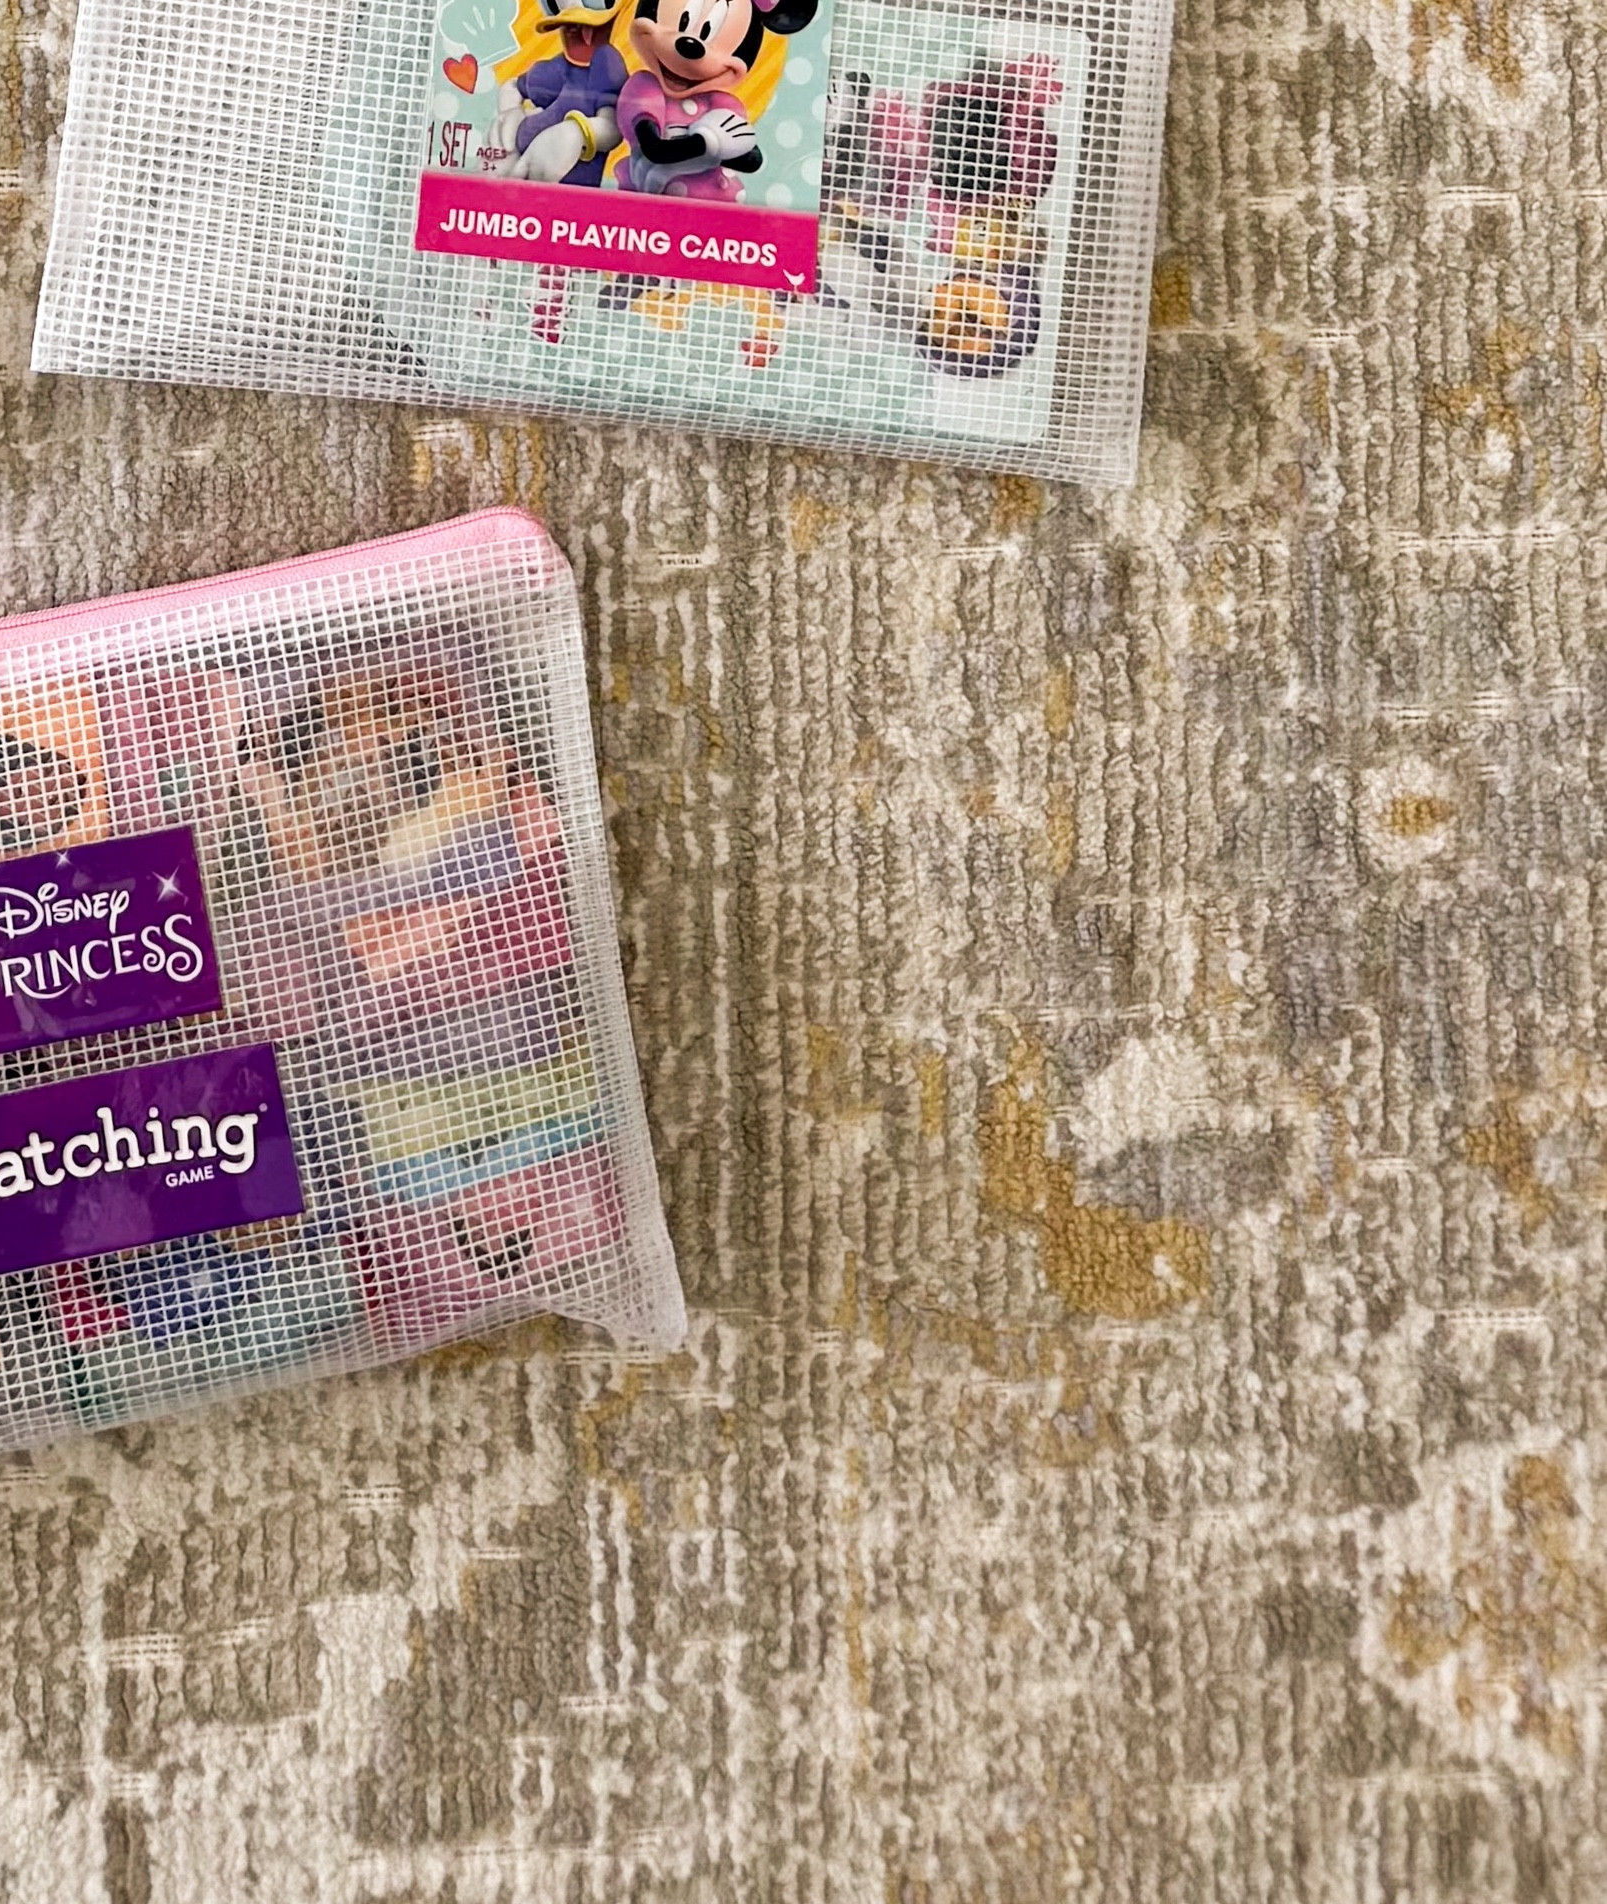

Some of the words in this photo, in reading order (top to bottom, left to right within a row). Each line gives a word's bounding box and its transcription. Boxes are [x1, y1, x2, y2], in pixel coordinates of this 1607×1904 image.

[427, 120, 435, 166] 1
[439, 120, 473, 168] SET
[476, 147, 508, 160] AGES
[482, 161, 497, 172] 3+
[439, 207, 543, 242] JUMBO
[550, 219, 673, 256] PLAYING
[680, 233, 778, 268] CARDS
[165, 1165, 215, 1189] GAME
